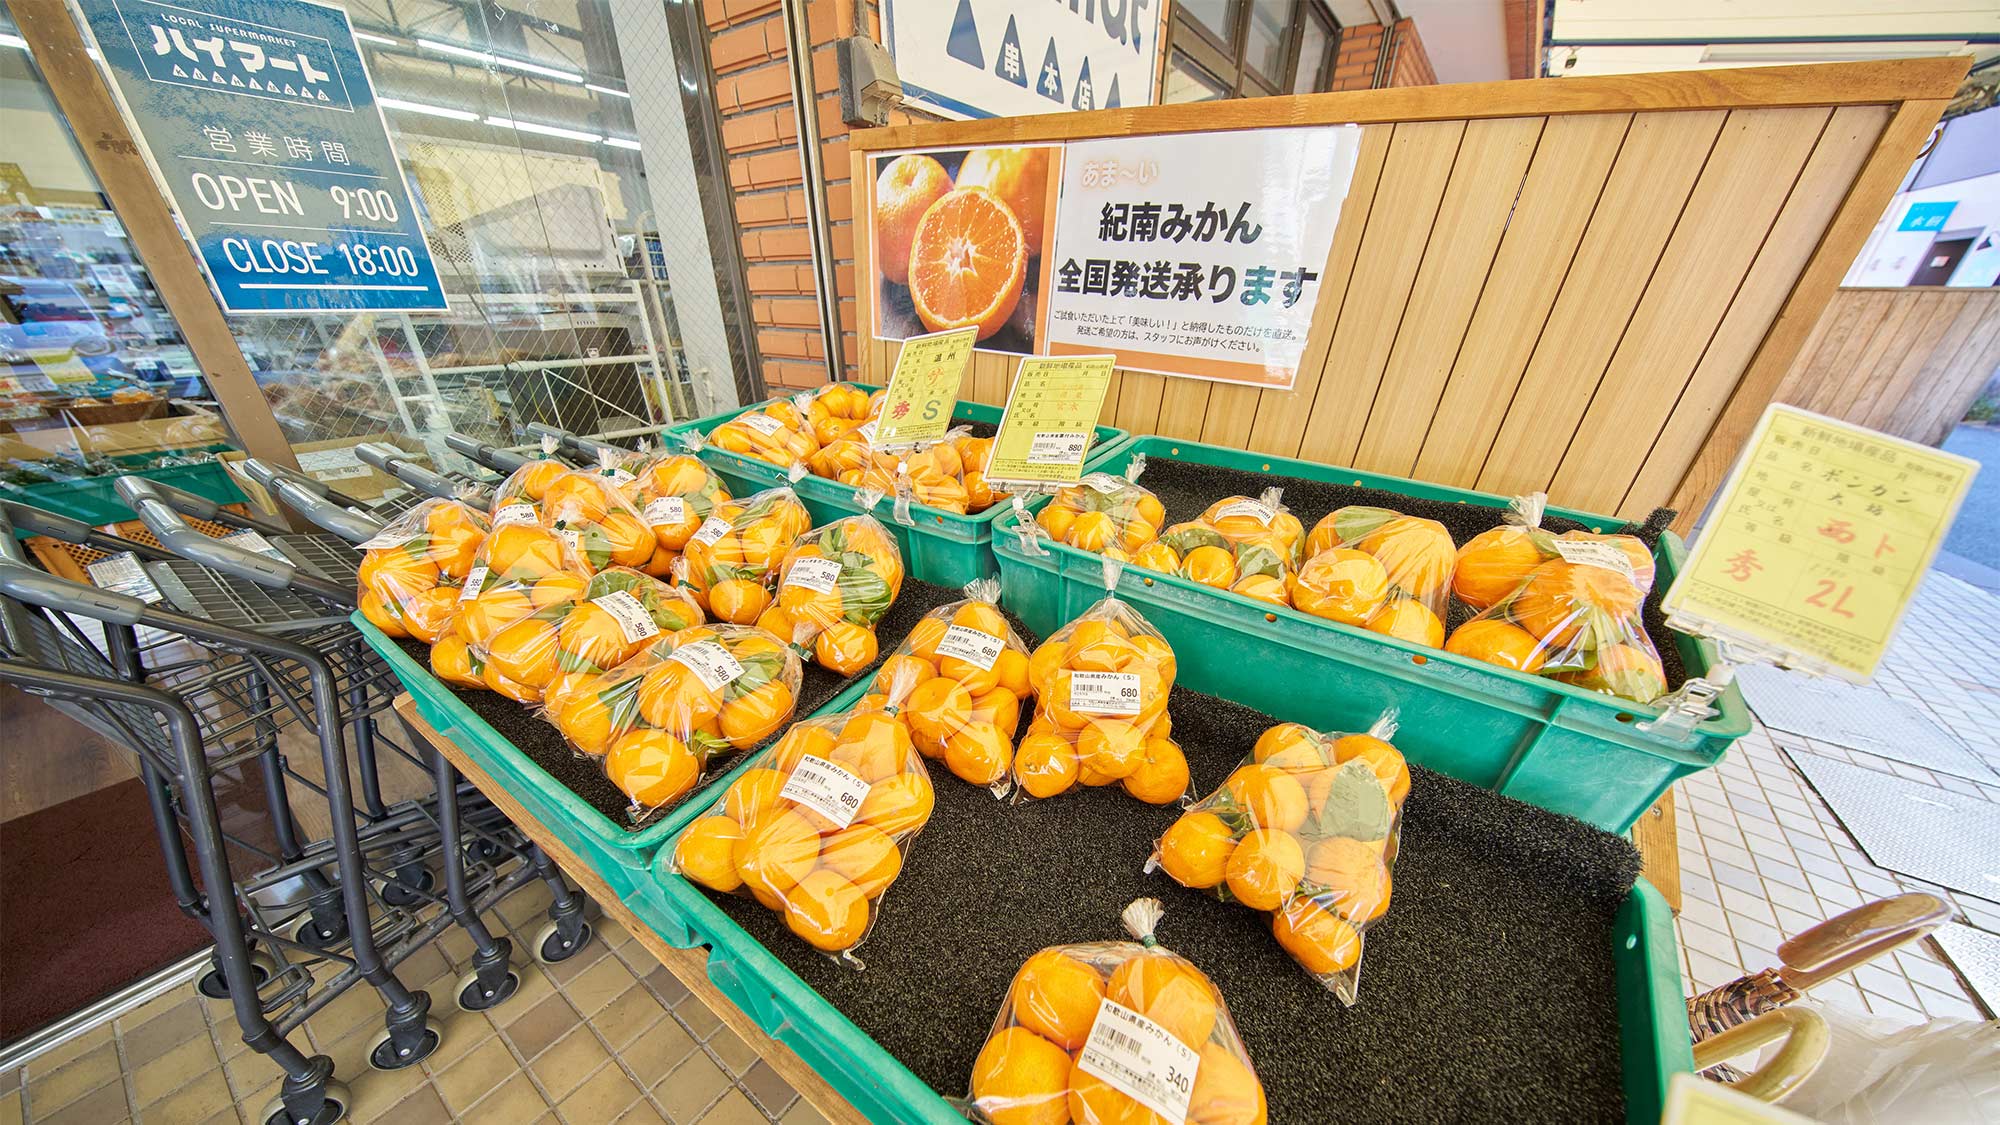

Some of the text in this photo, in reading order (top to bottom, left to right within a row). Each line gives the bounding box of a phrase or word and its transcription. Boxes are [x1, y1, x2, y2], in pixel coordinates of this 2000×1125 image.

[160, 13, 297, 48] LOCAL SUPERMARKET
[150, 24, 331, 84] ハイマート
[201, 124, 351, 166] 営業時間
[191, 172, 400, 223] OPEN 9:00
[1098, 201, 1263, 244] 紀南みかん
[222, 237, 419, 278] CLOSE 18:00
[1057, 258, 1318, 309] 全国発送承ります
[891, 400, 911, 420] 秀
[922, 399, 942, 421] S
[1067, 443, 1083, 452] 880
[519, 511, 535, 519] 580
[669, 506, 683, 514] 580
[710, 527, 724, 538] 580
[820, 571, 836, 582] 580
[1720, 549, 1765, 583] 秀
[1804, 579, 1857, 619] 2L
[634, 621, 648, 637] 580
[981, 646, 998, 658] 680
[714, 665, 730, 682] 580
[1120, 687, 1138, 698] 680
[840, 791, 859, 809] 680
[1166, 1065, 1189, 1093] 340
